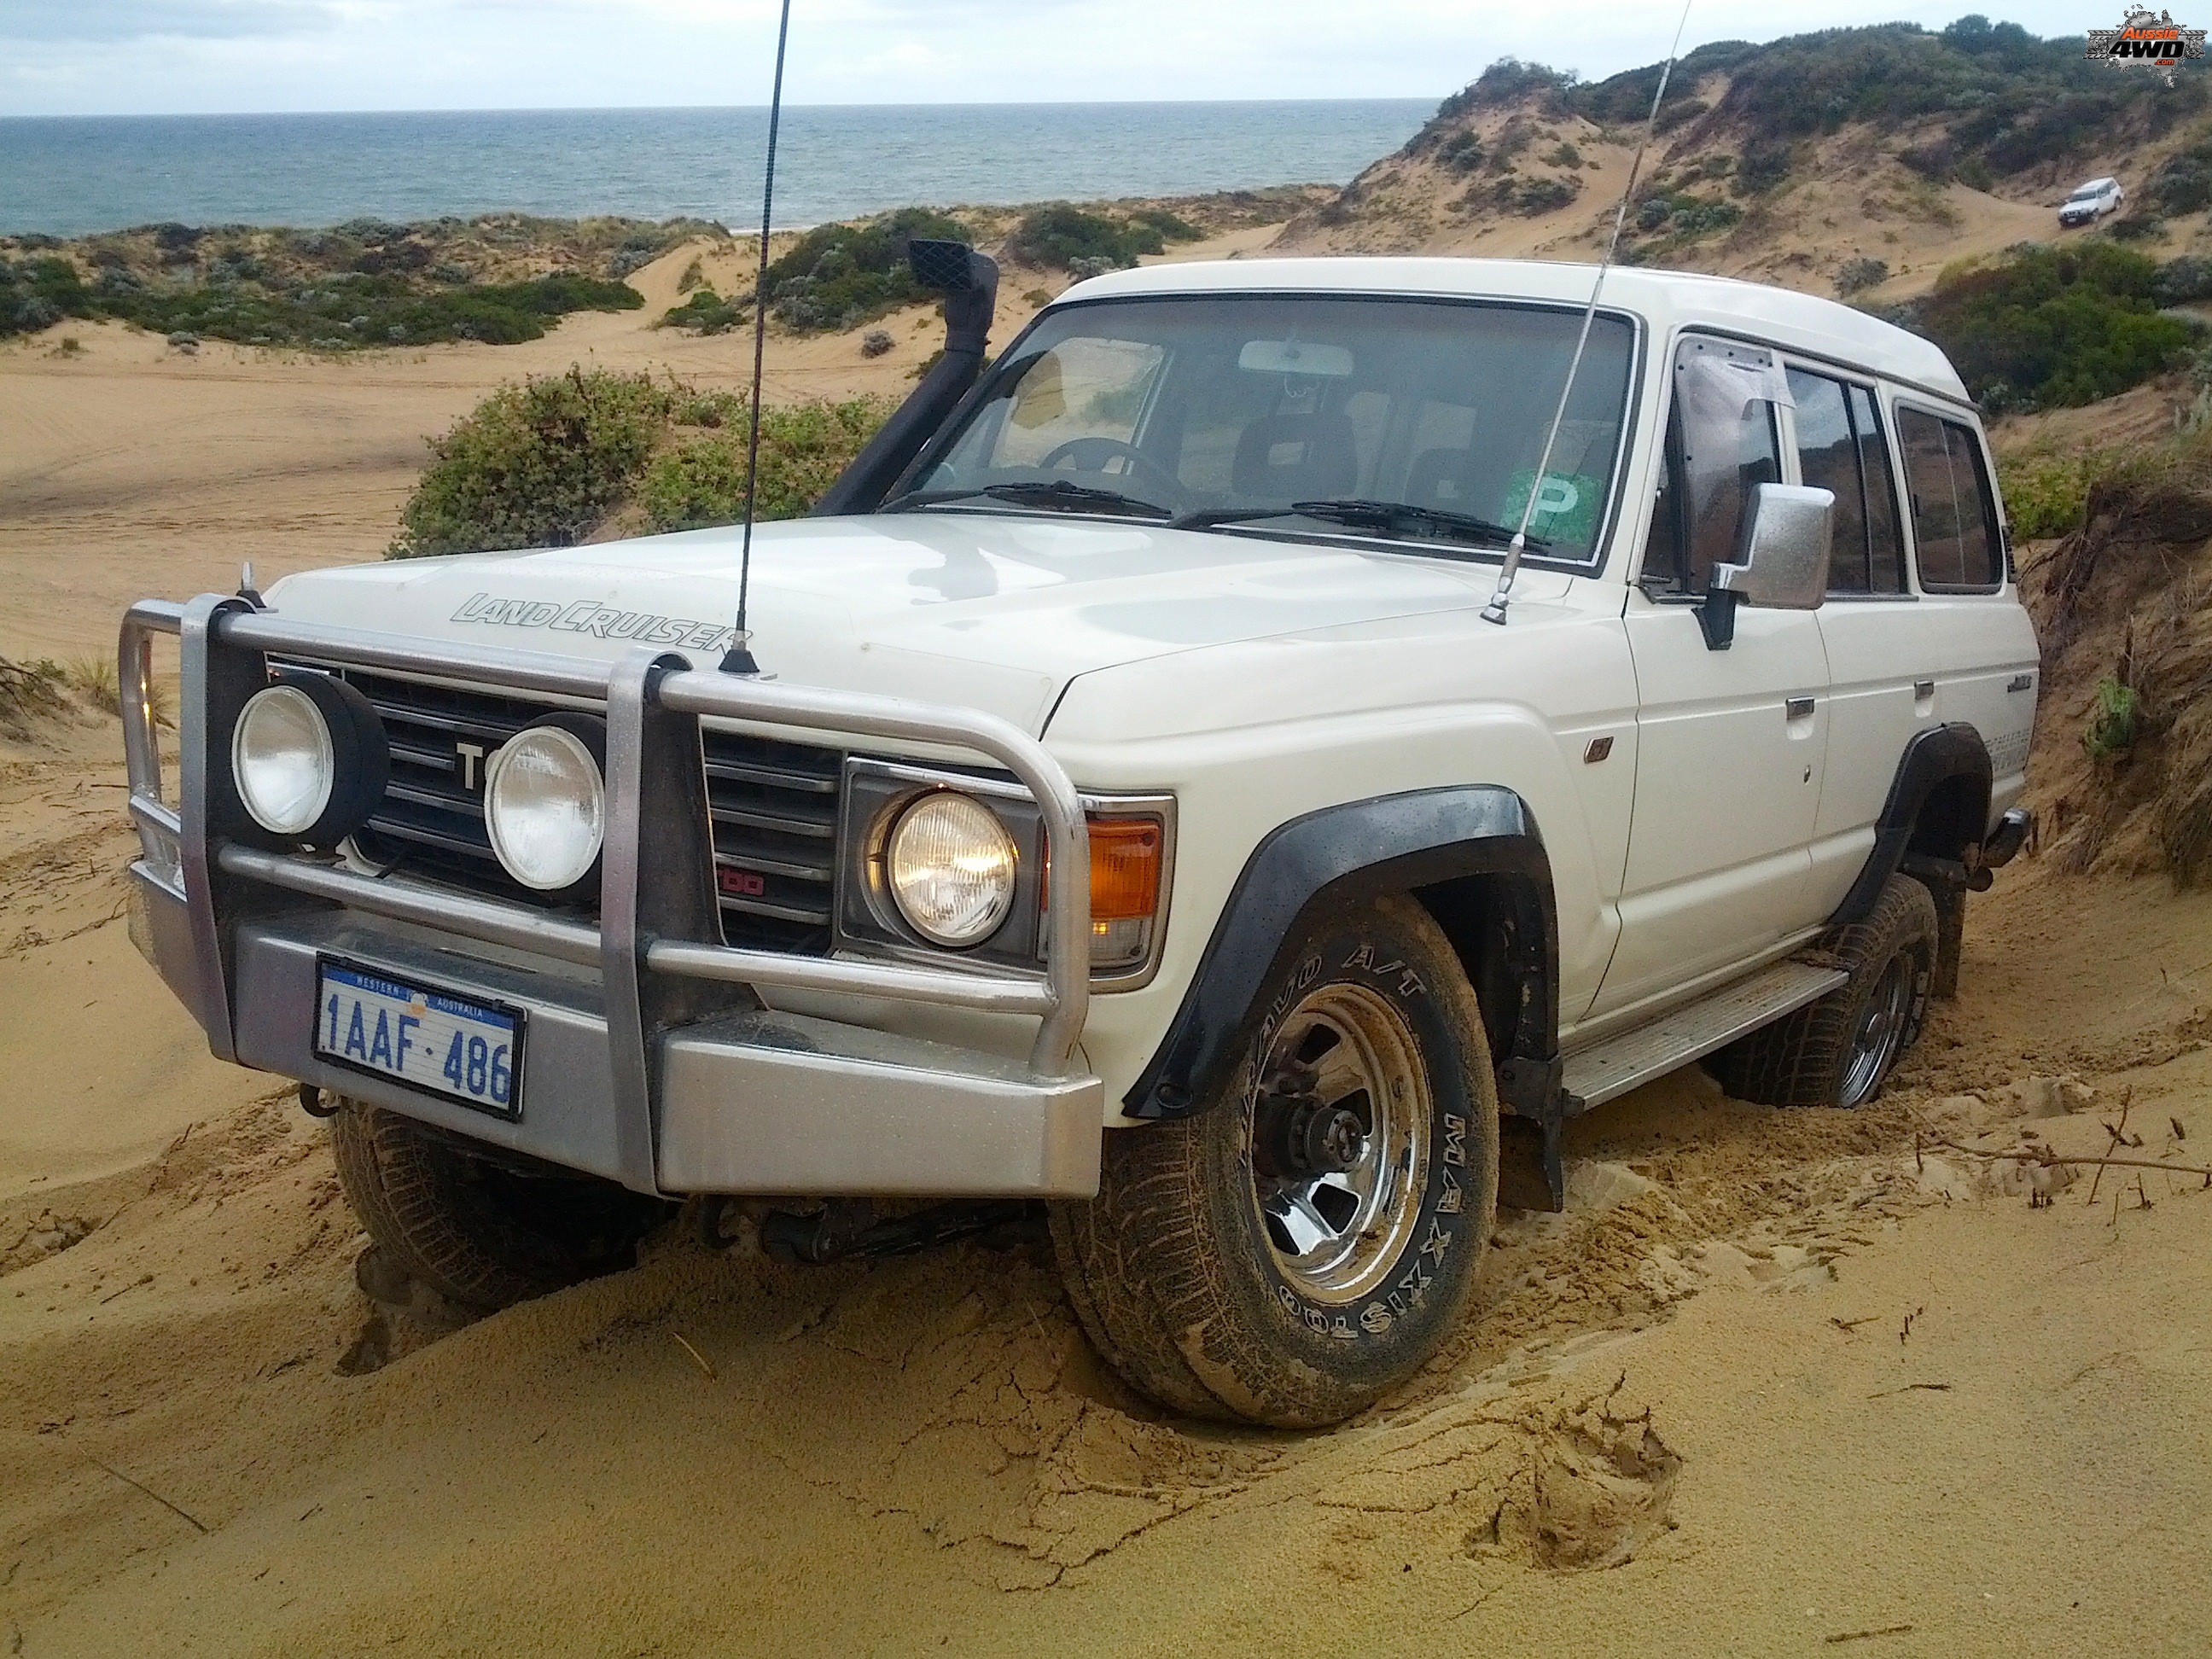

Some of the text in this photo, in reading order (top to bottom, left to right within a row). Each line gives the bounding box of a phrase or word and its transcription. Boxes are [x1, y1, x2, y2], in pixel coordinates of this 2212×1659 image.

[1527, 476, 1579, 527] P
[356, 975, 483, 1018] WESTERN AUSTRALIA
[1341, 942, 1428, 998] A/T
[1359, 1112, 1467, 1334] MAXXIS
